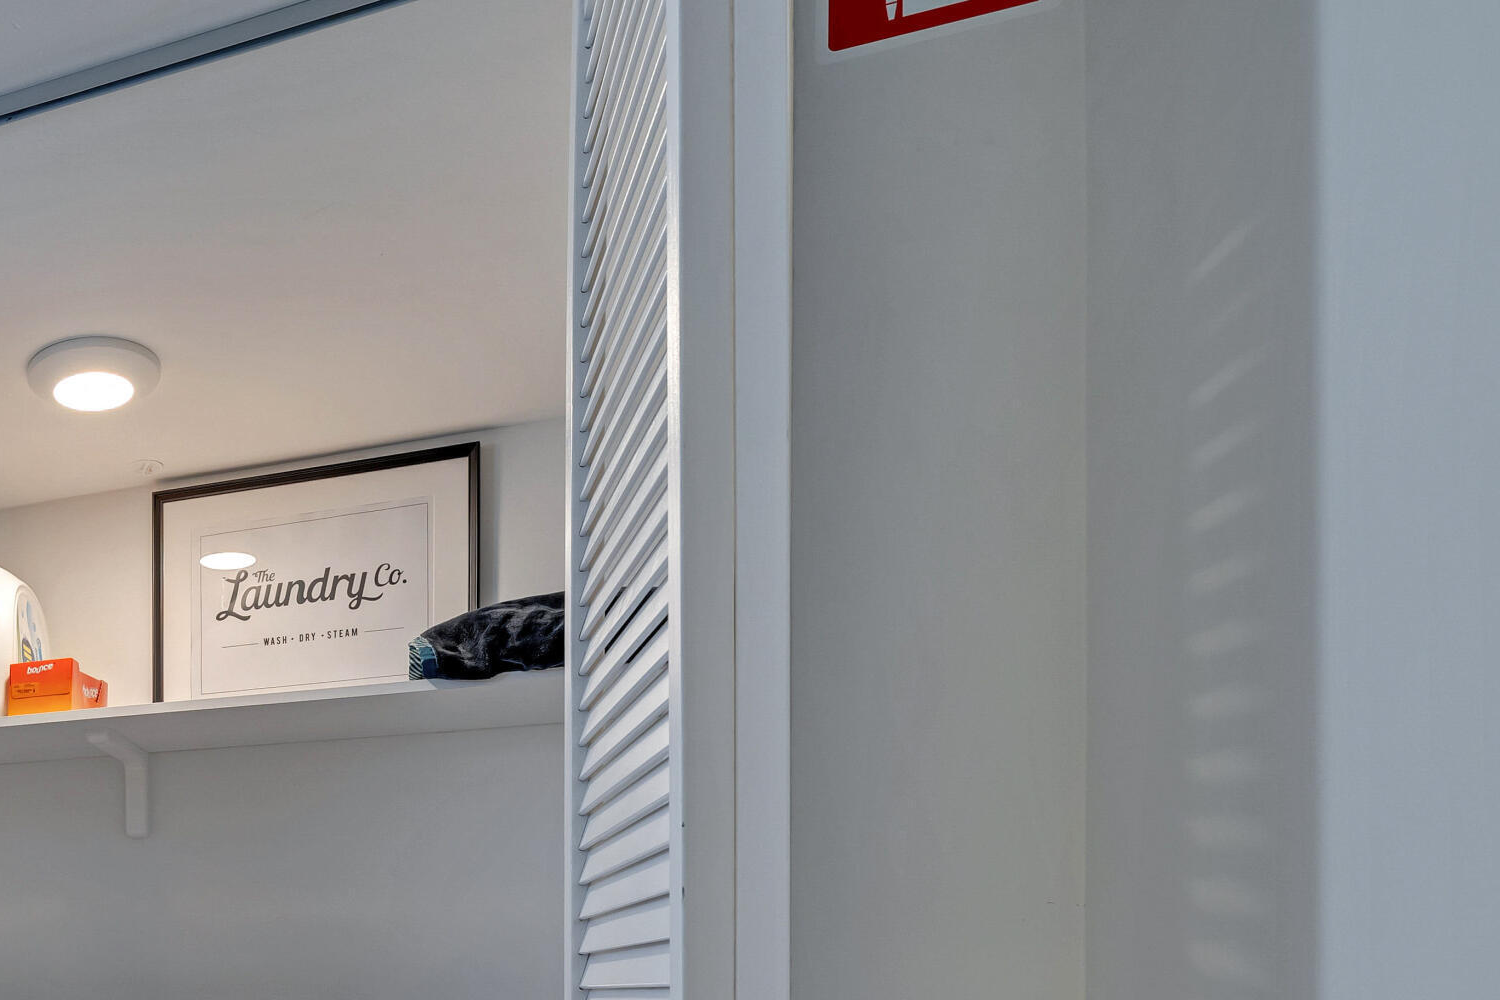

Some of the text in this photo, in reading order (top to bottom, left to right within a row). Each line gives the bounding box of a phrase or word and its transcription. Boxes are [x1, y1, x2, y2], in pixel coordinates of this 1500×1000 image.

[252, 568, 276, 583] The
[215, 563, 407, 621] Laundry Co.
[263, 628, 359, 647] WASH DRY STEAM
